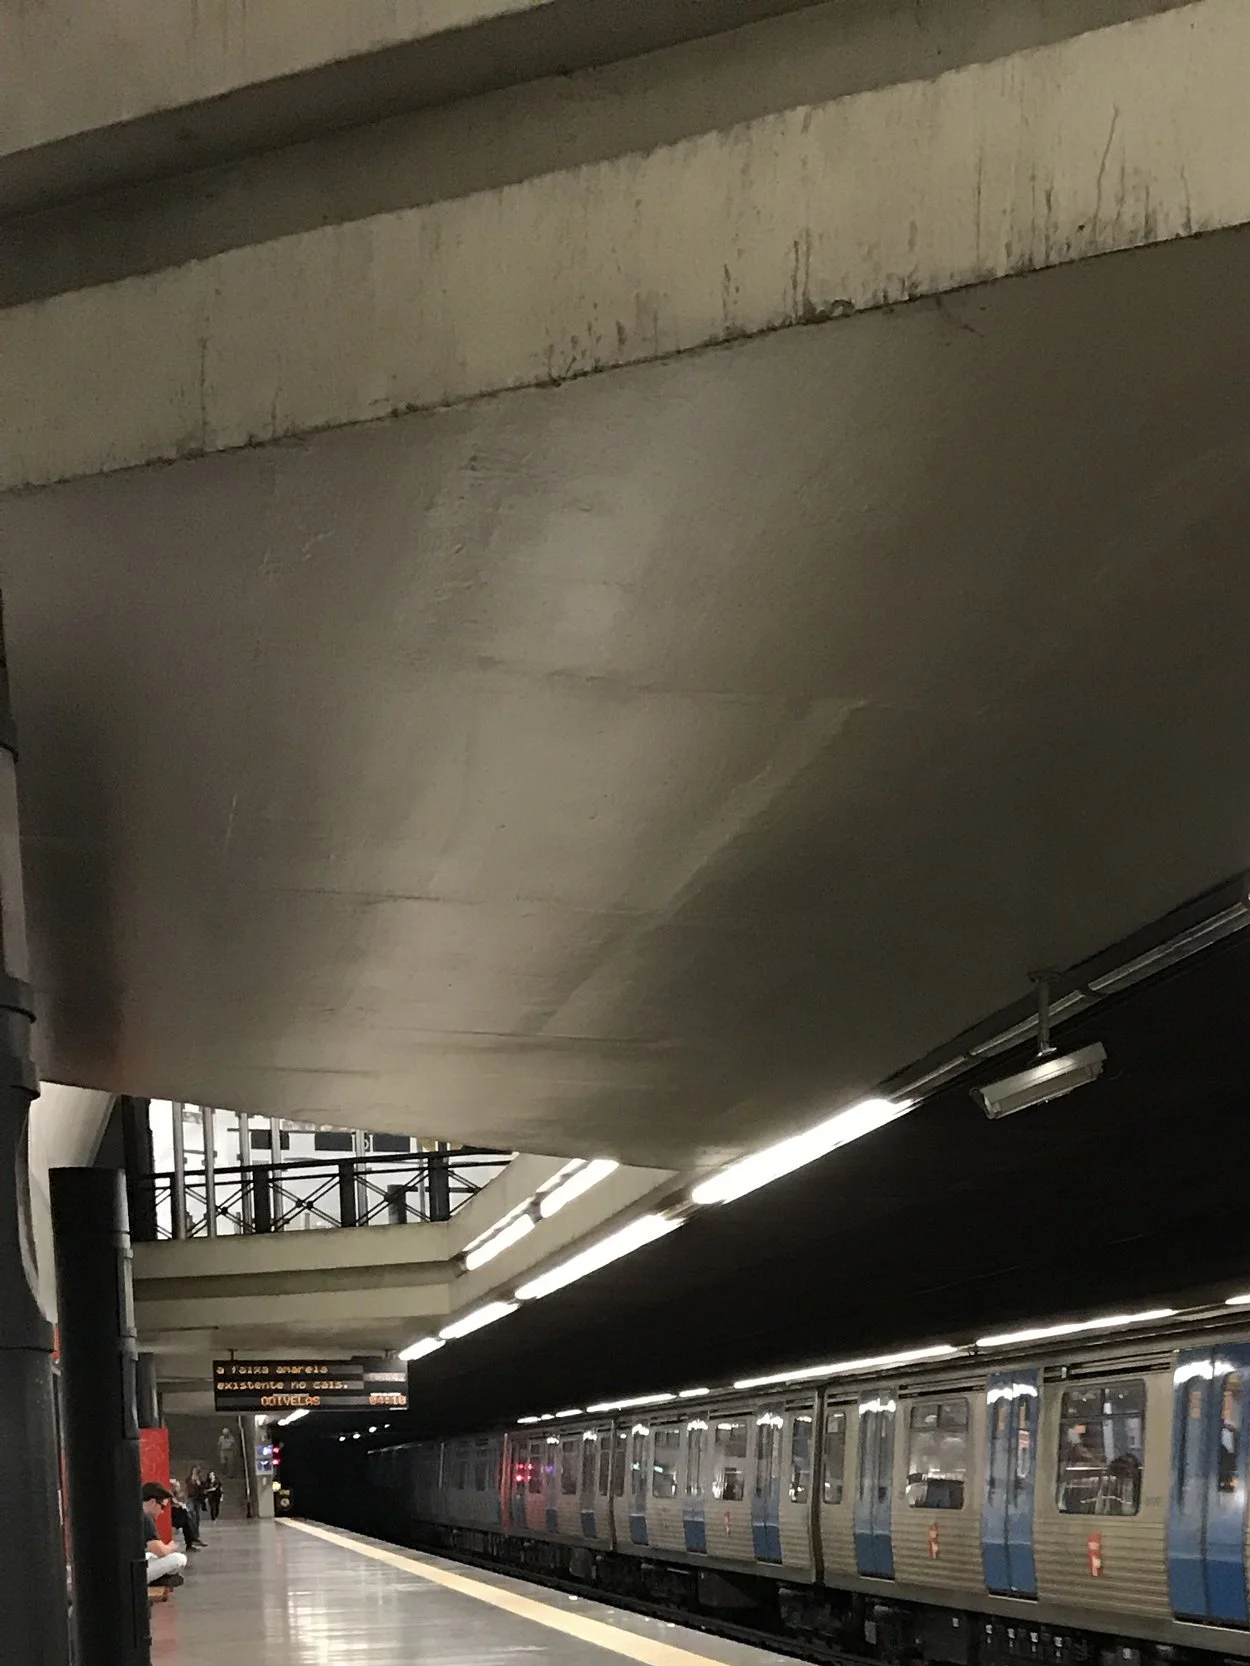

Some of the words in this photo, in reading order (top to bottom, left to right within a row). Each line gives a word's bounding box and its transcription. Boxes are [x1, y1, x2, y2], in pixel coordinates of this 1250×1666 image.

[216, 1381, 285, 1390] existente
[290, 1381, 307, 1390] no
[260, 1396, 321, 1407] ODIVELAS
